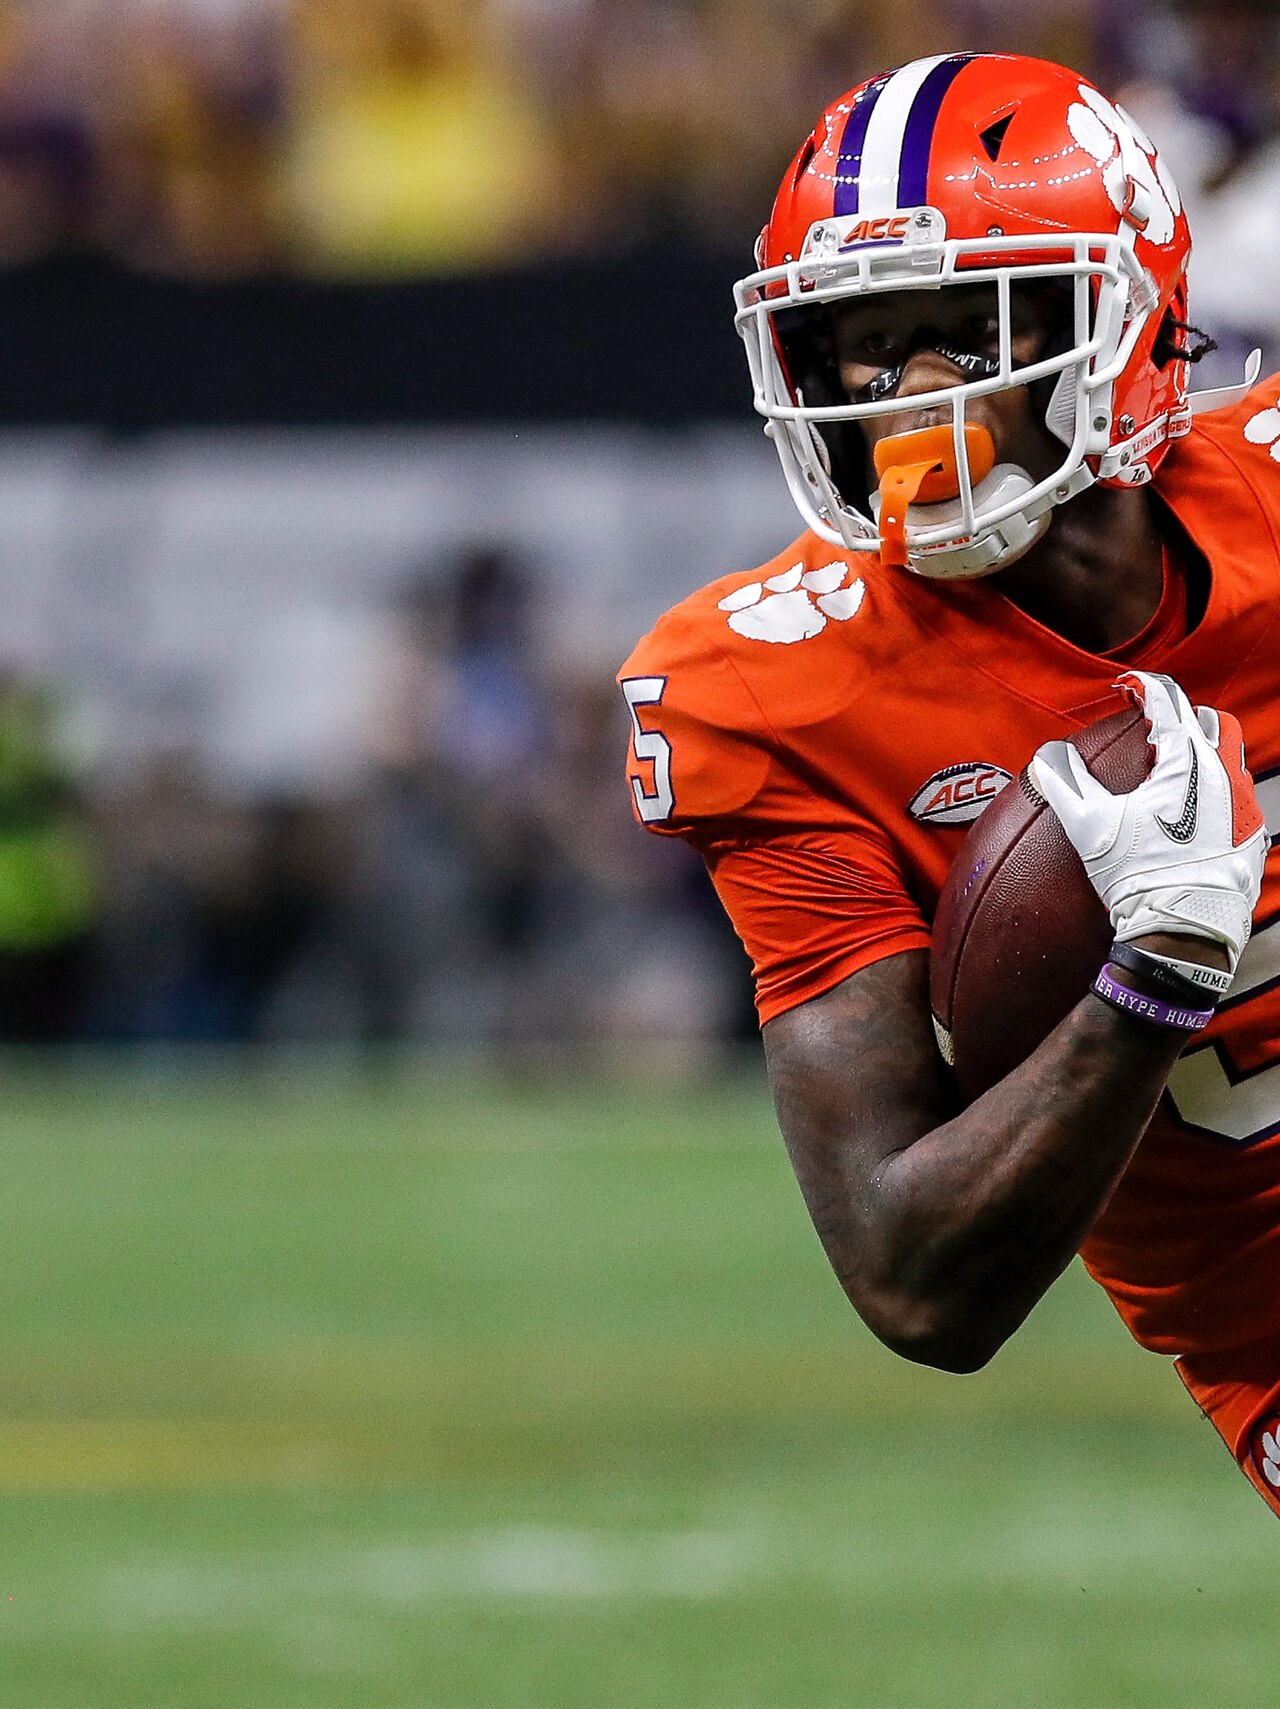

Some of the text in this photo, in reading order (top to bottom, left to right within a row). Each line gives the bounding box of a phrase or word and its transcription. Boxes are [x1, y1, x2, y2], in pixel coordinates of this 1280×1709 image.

[843, 217, 911, 244] ACC
[620, 675, 677, 824] 5
[924, 770, 998, 812] ACC
[1116, 992, 1159, 1018] HYPE
